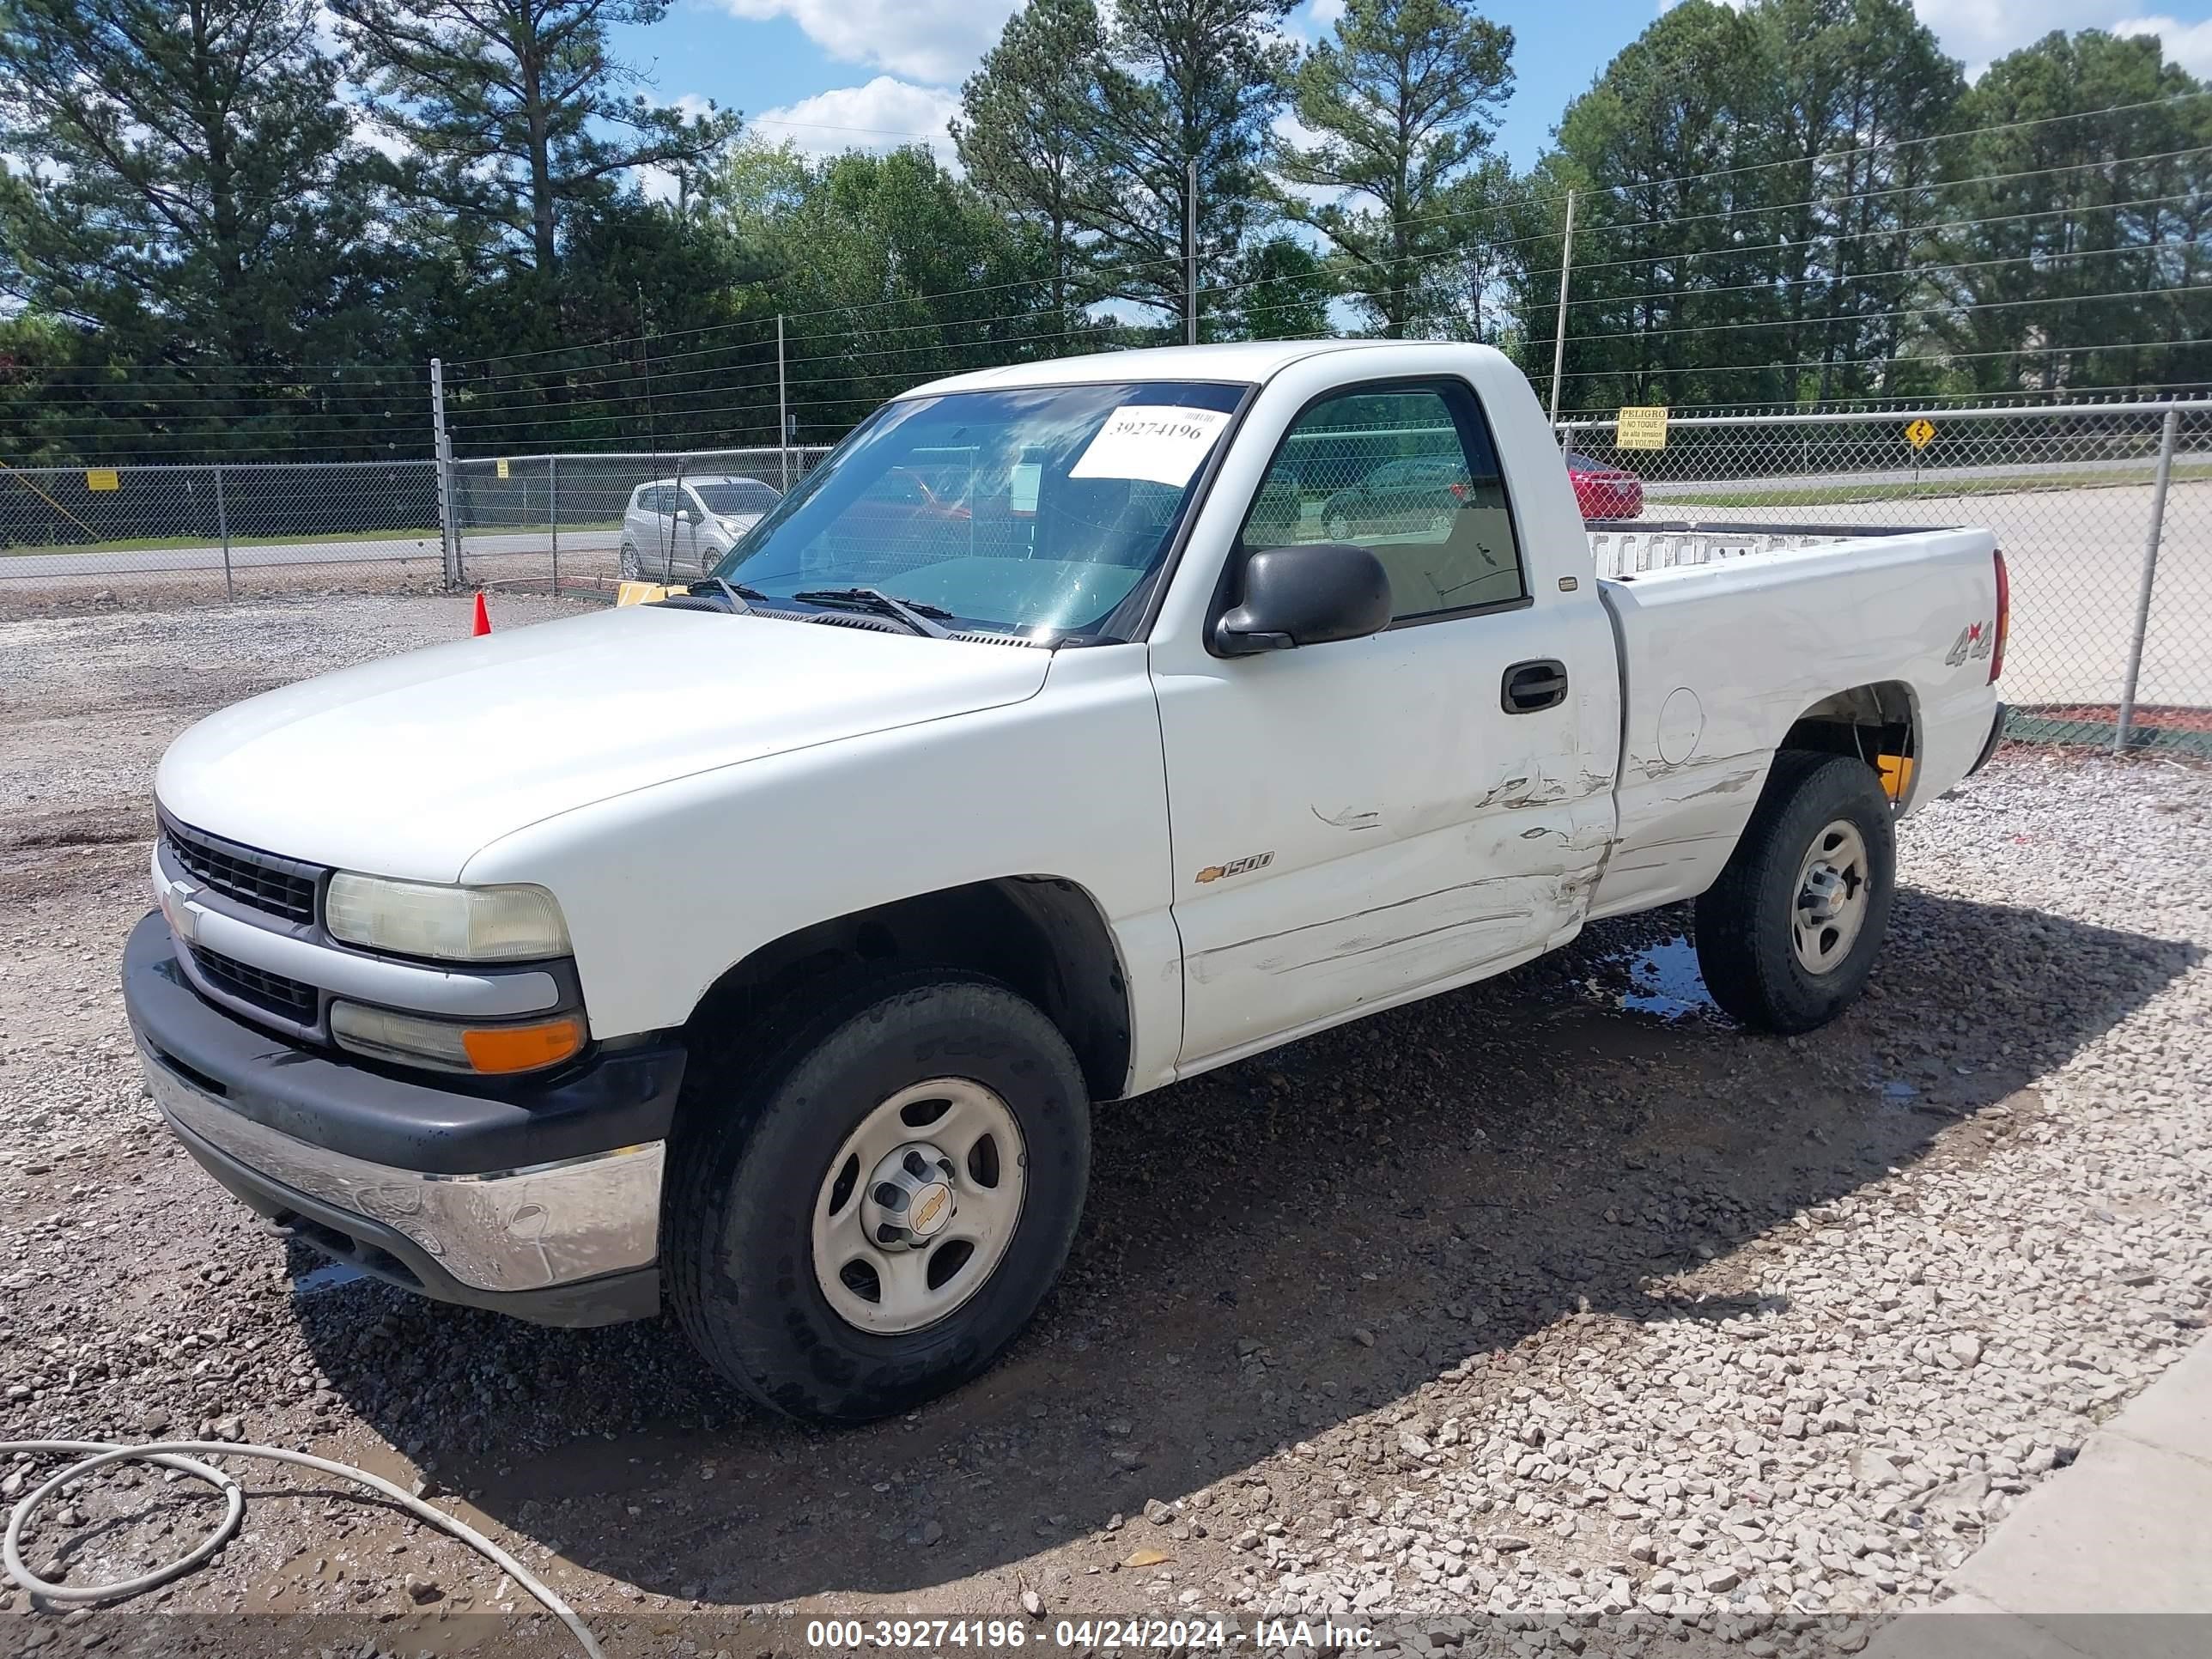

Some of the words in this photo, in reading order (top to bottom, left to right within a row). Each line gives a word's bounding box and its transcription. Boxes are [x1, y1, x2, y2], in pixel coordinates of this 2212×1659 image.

[1622, 410, 1666, 418] PELIGRO
[1109, 421, 1204, 441] 39274196
[1635, 439, 1663, 447] VOLTIOS
[1222, 851, 1275, 878] 1500
